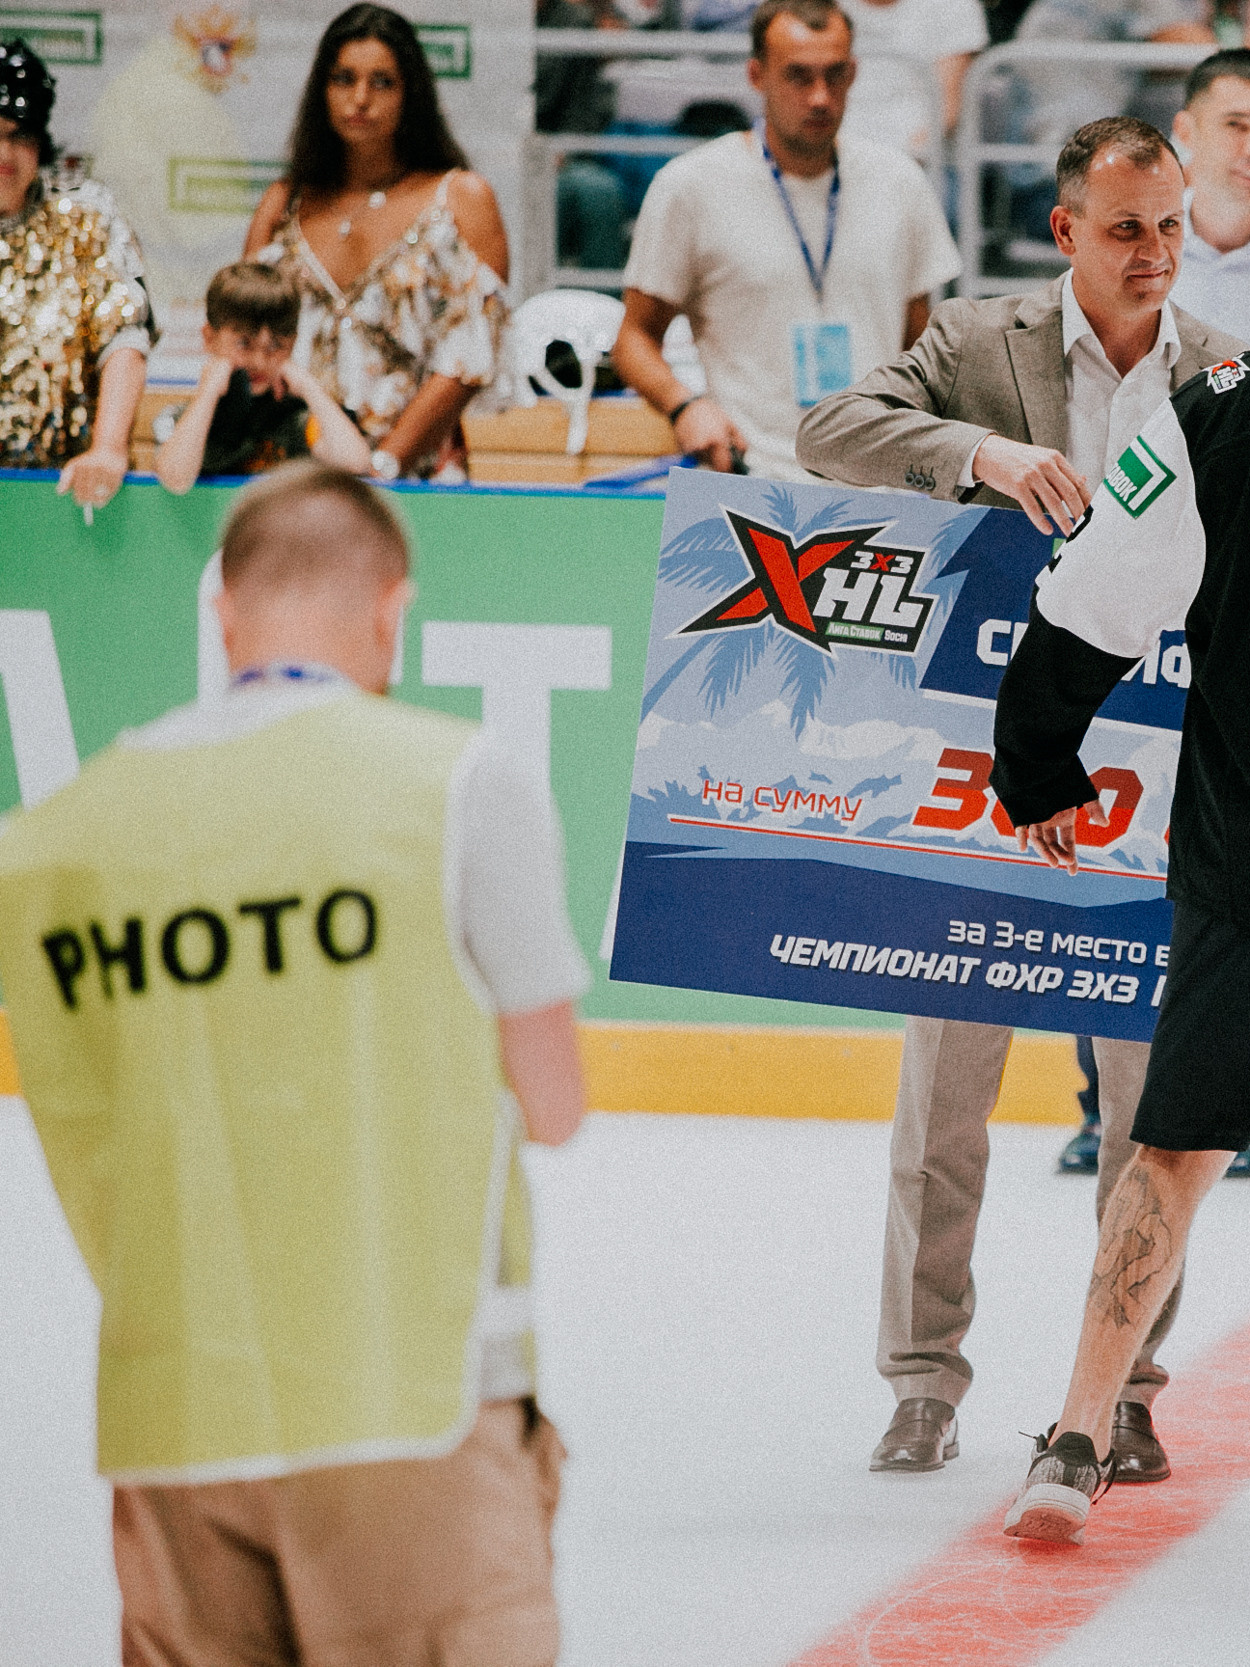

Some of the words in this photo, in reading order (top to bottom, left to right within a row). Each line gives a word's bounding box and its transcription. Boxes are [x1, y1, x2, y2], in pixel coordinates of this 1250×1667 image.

[703, 780, 743, 803] на
[754, 786, 863, 821] сумму
[912, 747, 1144, 848] 30
[40, 888, 379, 1012] PHOTO
[769, 934, 982, 985] ЧЕМПИОНАТ
[985, 961, 1064, 994] ФХР
[947, 920, 986, 945] за
[993, 920, 1044, 951] 3-е
[1051, 932, 1147, 964] место
